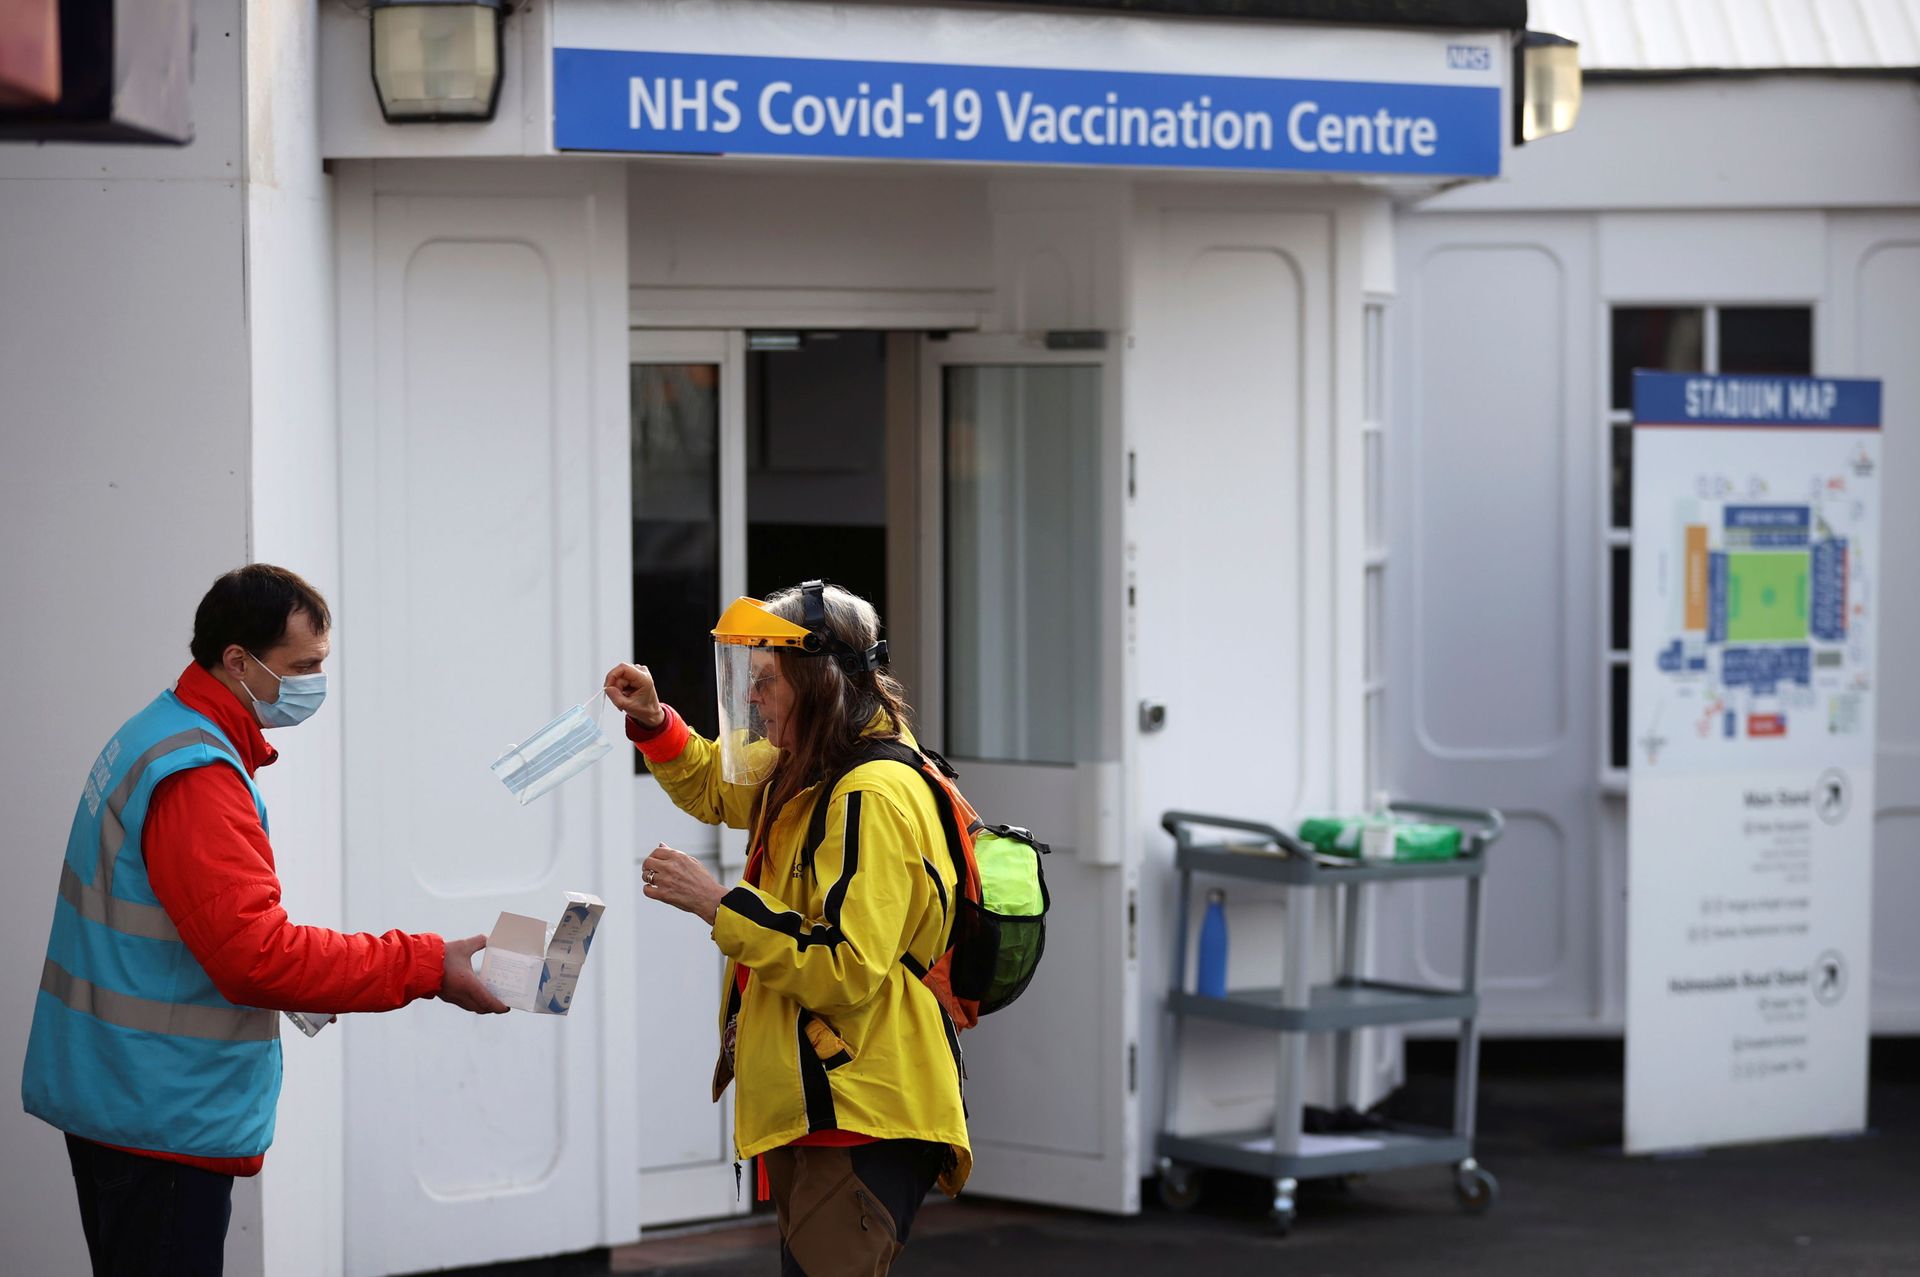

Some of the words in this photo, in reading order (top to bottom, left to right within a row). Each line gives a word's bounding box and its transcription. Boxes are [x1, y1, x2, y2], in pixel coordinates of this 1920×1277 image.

[1447, 46, 1490, 70] NHS
[629, 76, 742, 134] NHS
[758, 81, 983, 142] Covid-19
[996, 90, 1273, 151] Vaccination
[1286, 101, 1438, 157] Centre
[1685, 378, 1783, 419] STADIUM
[1788, 380, 1838, 420] MAP
